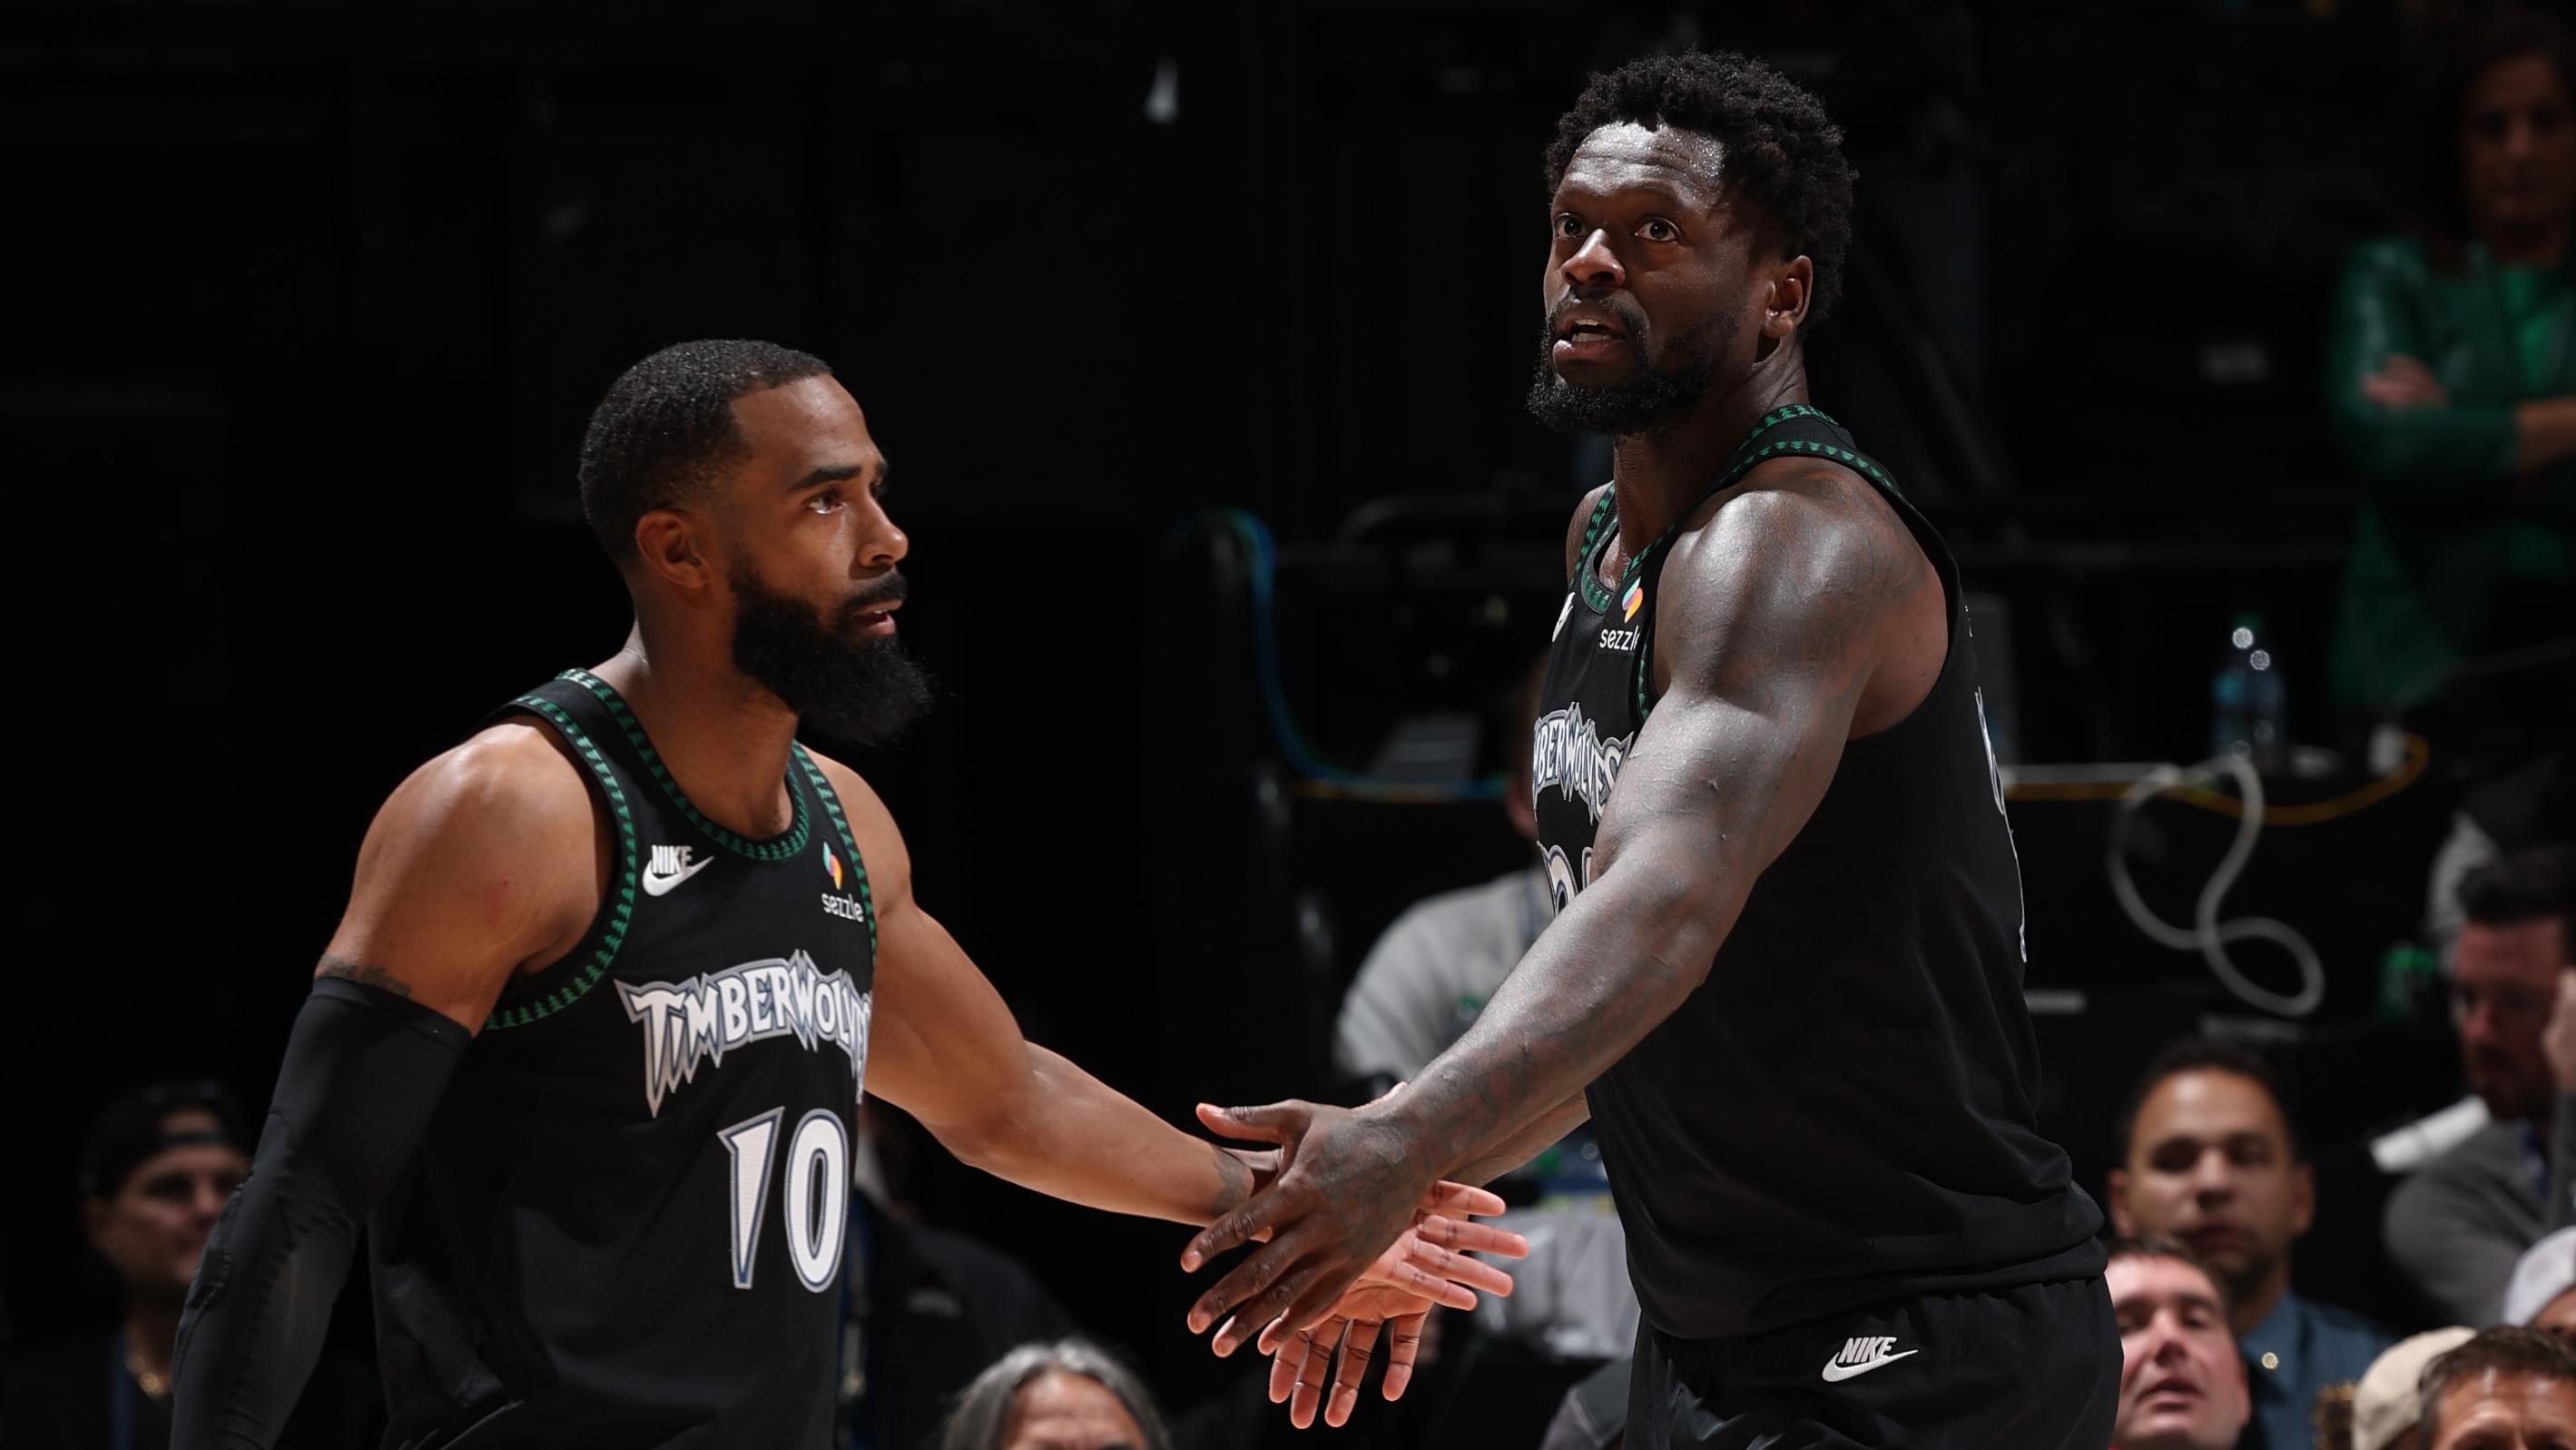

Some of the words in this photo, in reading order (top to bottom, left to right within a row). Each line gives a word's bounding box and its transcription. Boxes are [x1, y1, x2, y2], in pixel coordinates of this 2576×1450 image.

[651, 844, 693, 874] NIKE
[821, 893, 864, 922] sezzle
[717, 1106, 850, 1293] 10
[1837, 1336, 1897, 1363] NIKE
